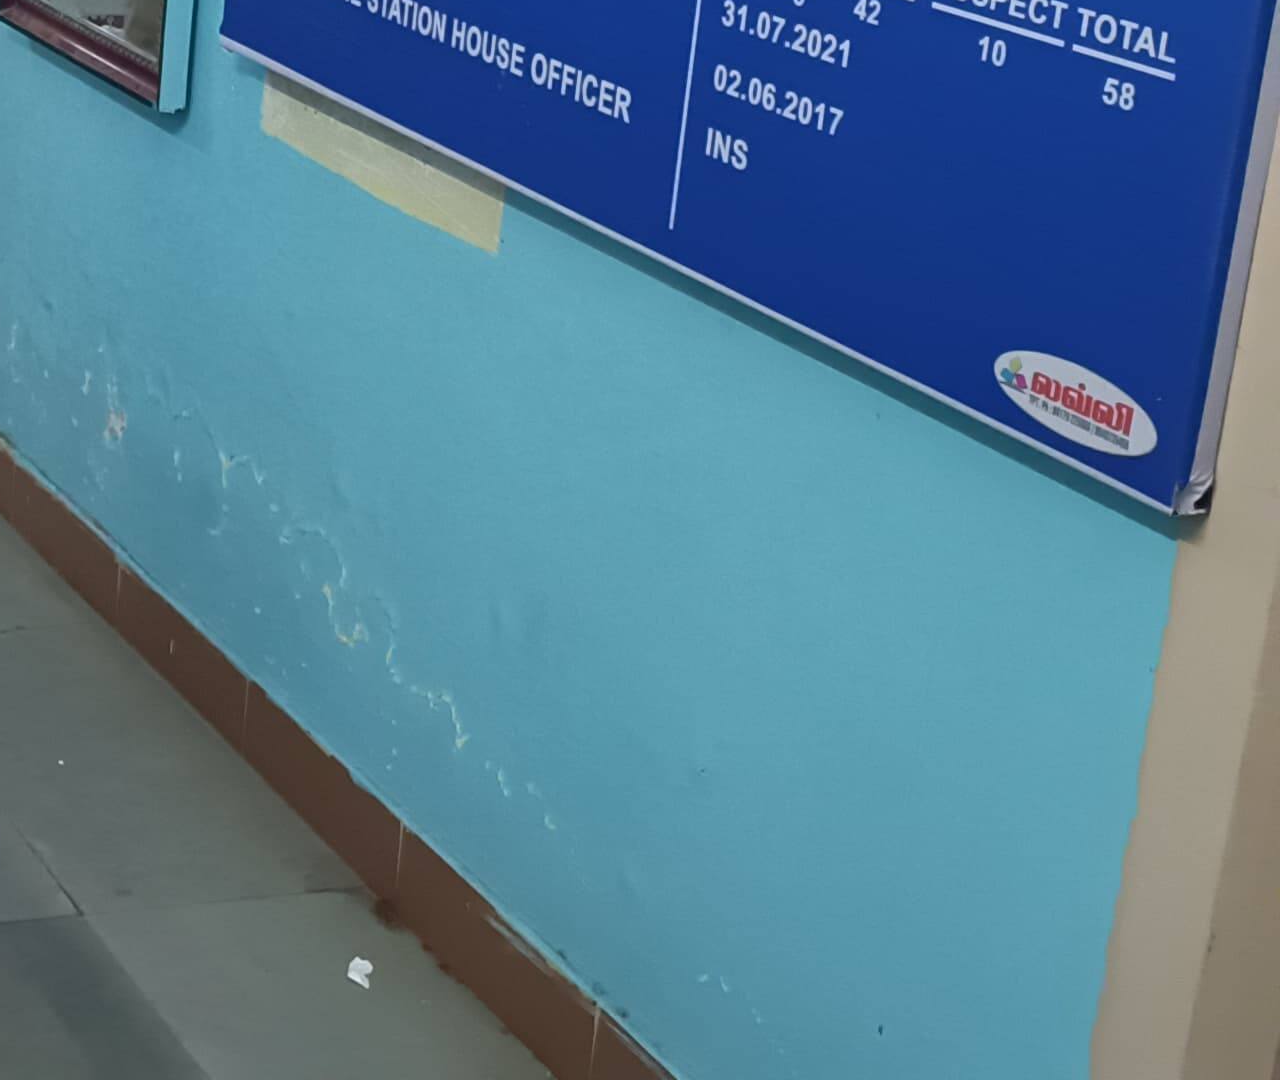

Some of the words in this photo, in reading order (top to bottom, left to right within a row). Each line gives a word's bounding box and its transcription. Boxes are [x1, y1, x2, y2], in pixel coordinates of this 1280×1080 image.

[722, 0, 849, 67] 31.07.2021
[1078, 8, 1174, 62] TOTAL
[452, 20, 524, 76] HOUSE
[532, 54, 630, 122] OFFICER
[714, 65, 843, 134] 02.06.2017
[706, 128, 747, 169] INS
